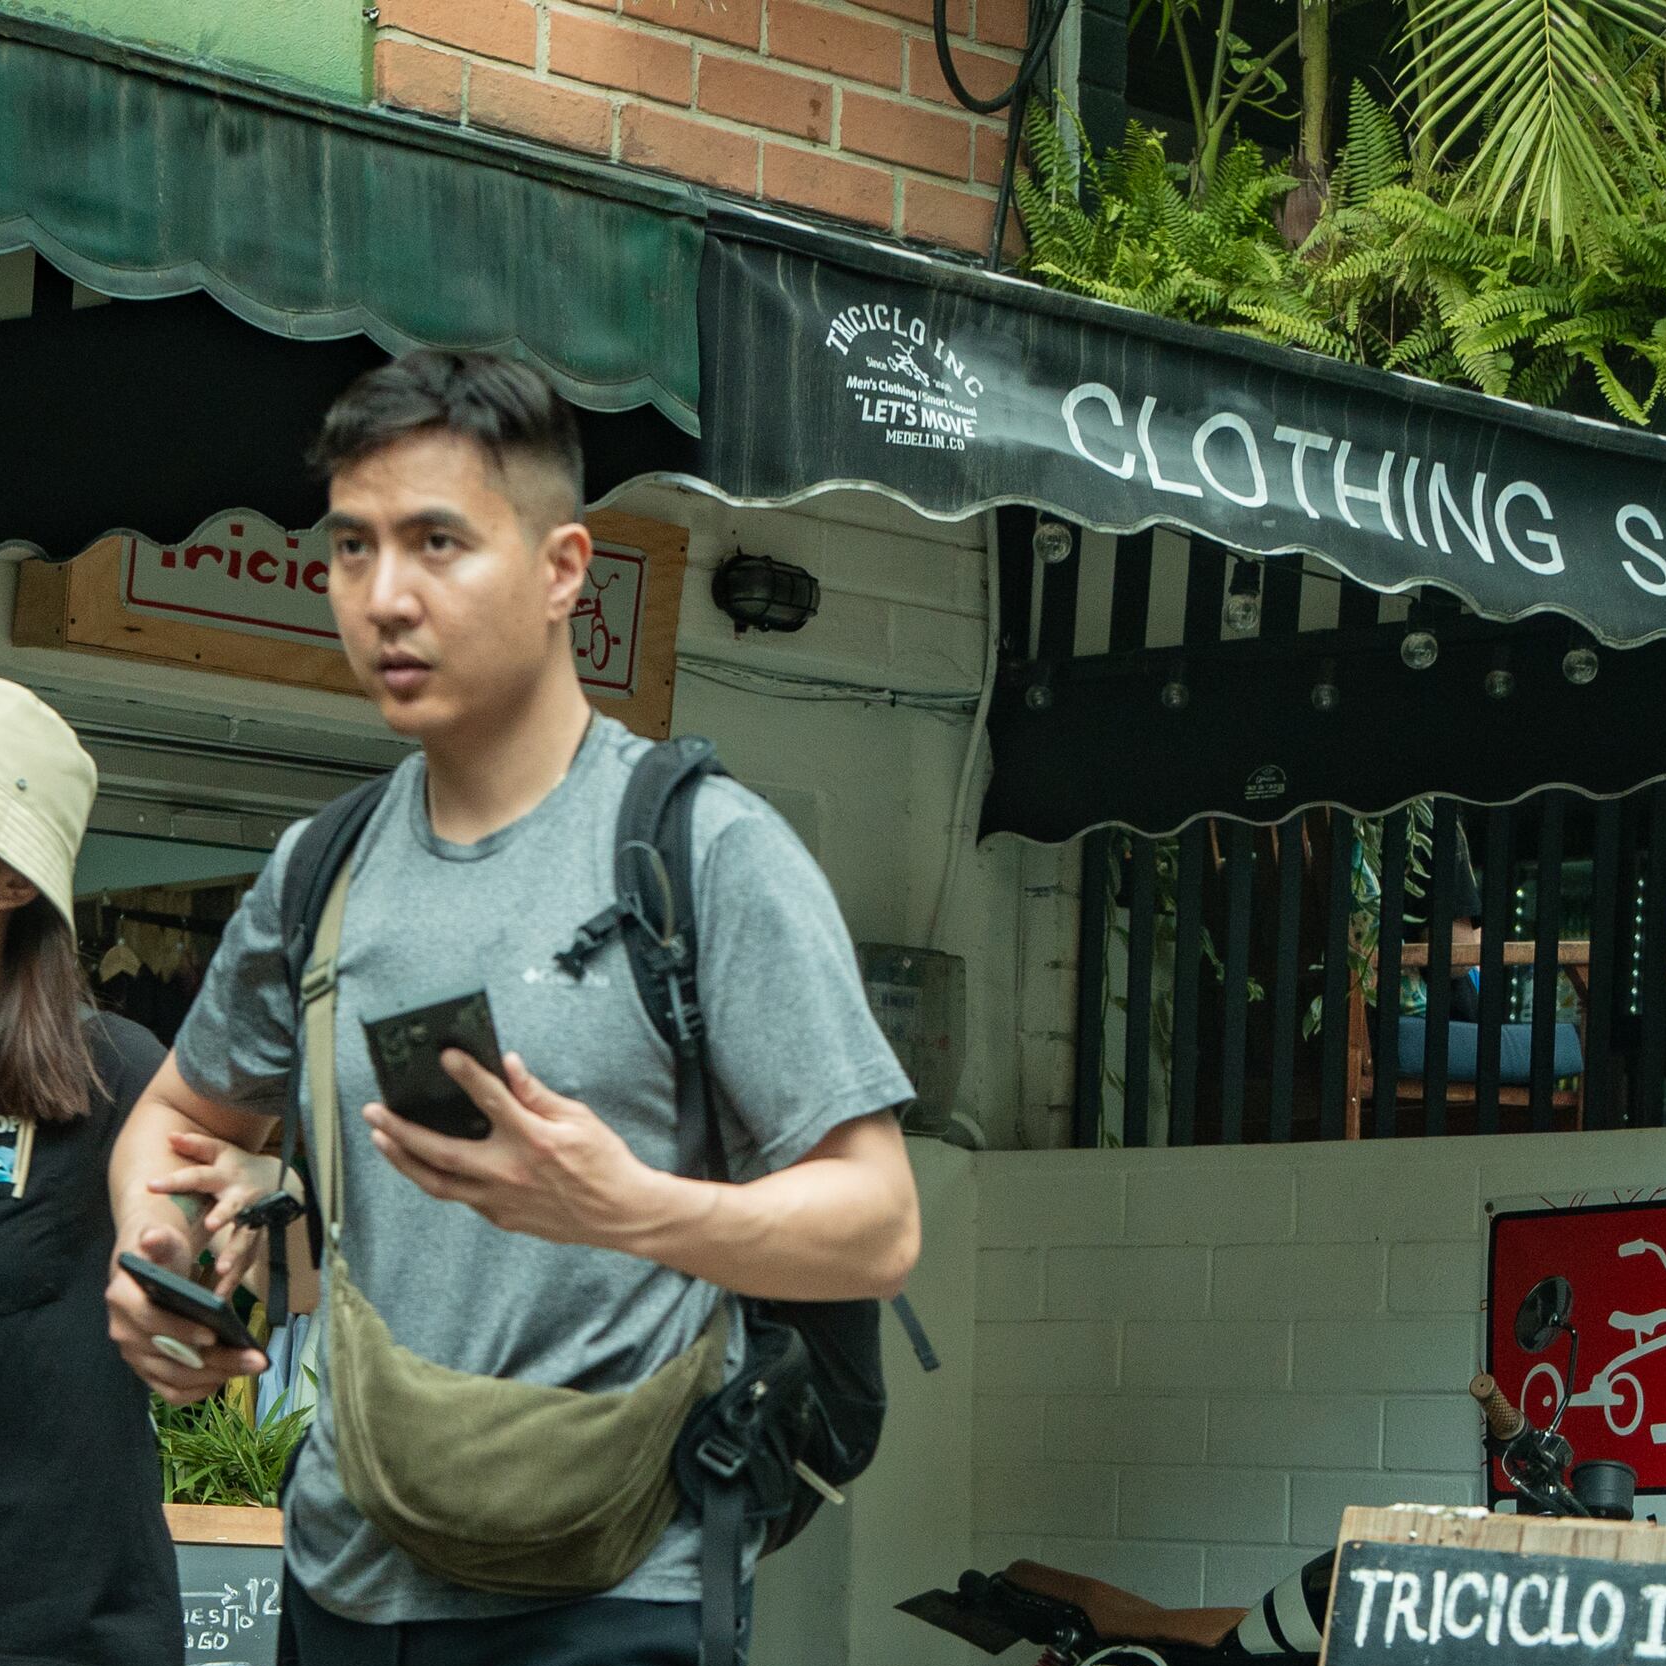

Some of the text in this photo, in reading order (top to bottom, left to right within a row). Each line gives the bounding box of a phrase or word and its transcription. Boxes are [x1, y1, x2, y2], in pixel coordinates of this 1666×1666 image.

[825, 303, 983, 399] TRICICLO INC
[865, 356, 888, 372] Since
[846, 375, 878, 391] Men's
[878, 380, 918, 402] Clothing
[922, 392, 949, 408] Smart
[949, 400, 978, 418] Casual
[1060, 382, 1566, 576] CLOTHING
[1349, 1567, 1626, 1650] TRICICLO
